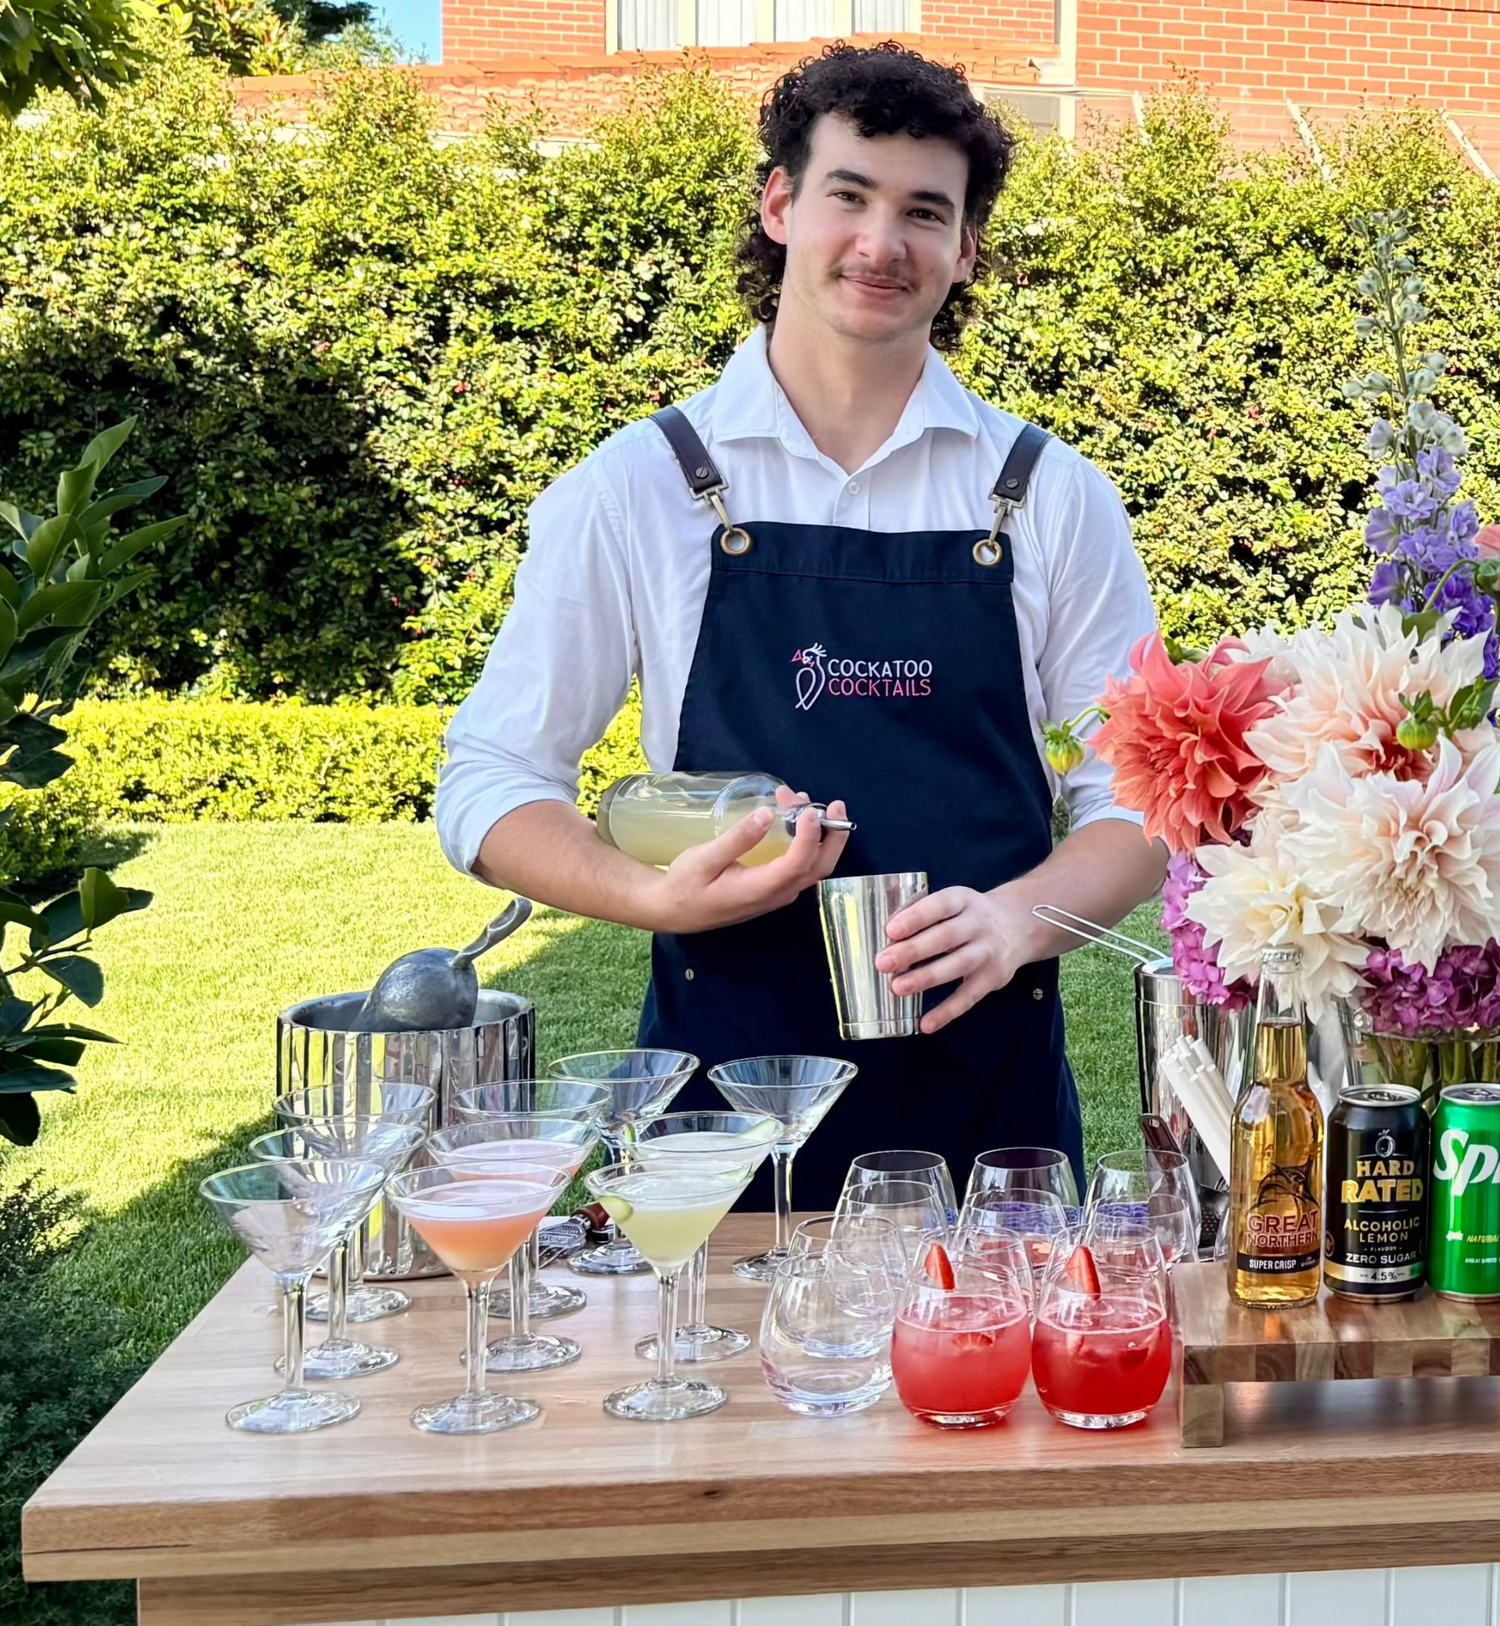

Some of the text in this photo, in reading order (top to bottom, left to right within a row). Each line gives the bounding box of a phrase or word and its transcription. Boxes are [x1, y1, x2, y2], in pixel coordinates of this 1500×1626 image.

[827, 659, 933, 678] COCKATOO
[828, 677, 932, 696] COCKTAILS
[1356, 1160, 1415, 1177] HARD
[1341, 1178, 1424, 1203] RATED
[1246, 1210, 1319, 1234] GREAT
[1344, 1216, 1419, 1232] ALCOHOLIC
[1246, 1231, 1318, 1248] NORTHERN
[1359, 1231, 1408, 1243] LEMON
[1248, 1259, 1273, 1270] SUPER
[1274, 1259, 1297, 1270] CRISP
[1345, 1251, 1417, 1264] ZERO SUGAR
[1370, 1270, 1398, 1281] 4.5%
